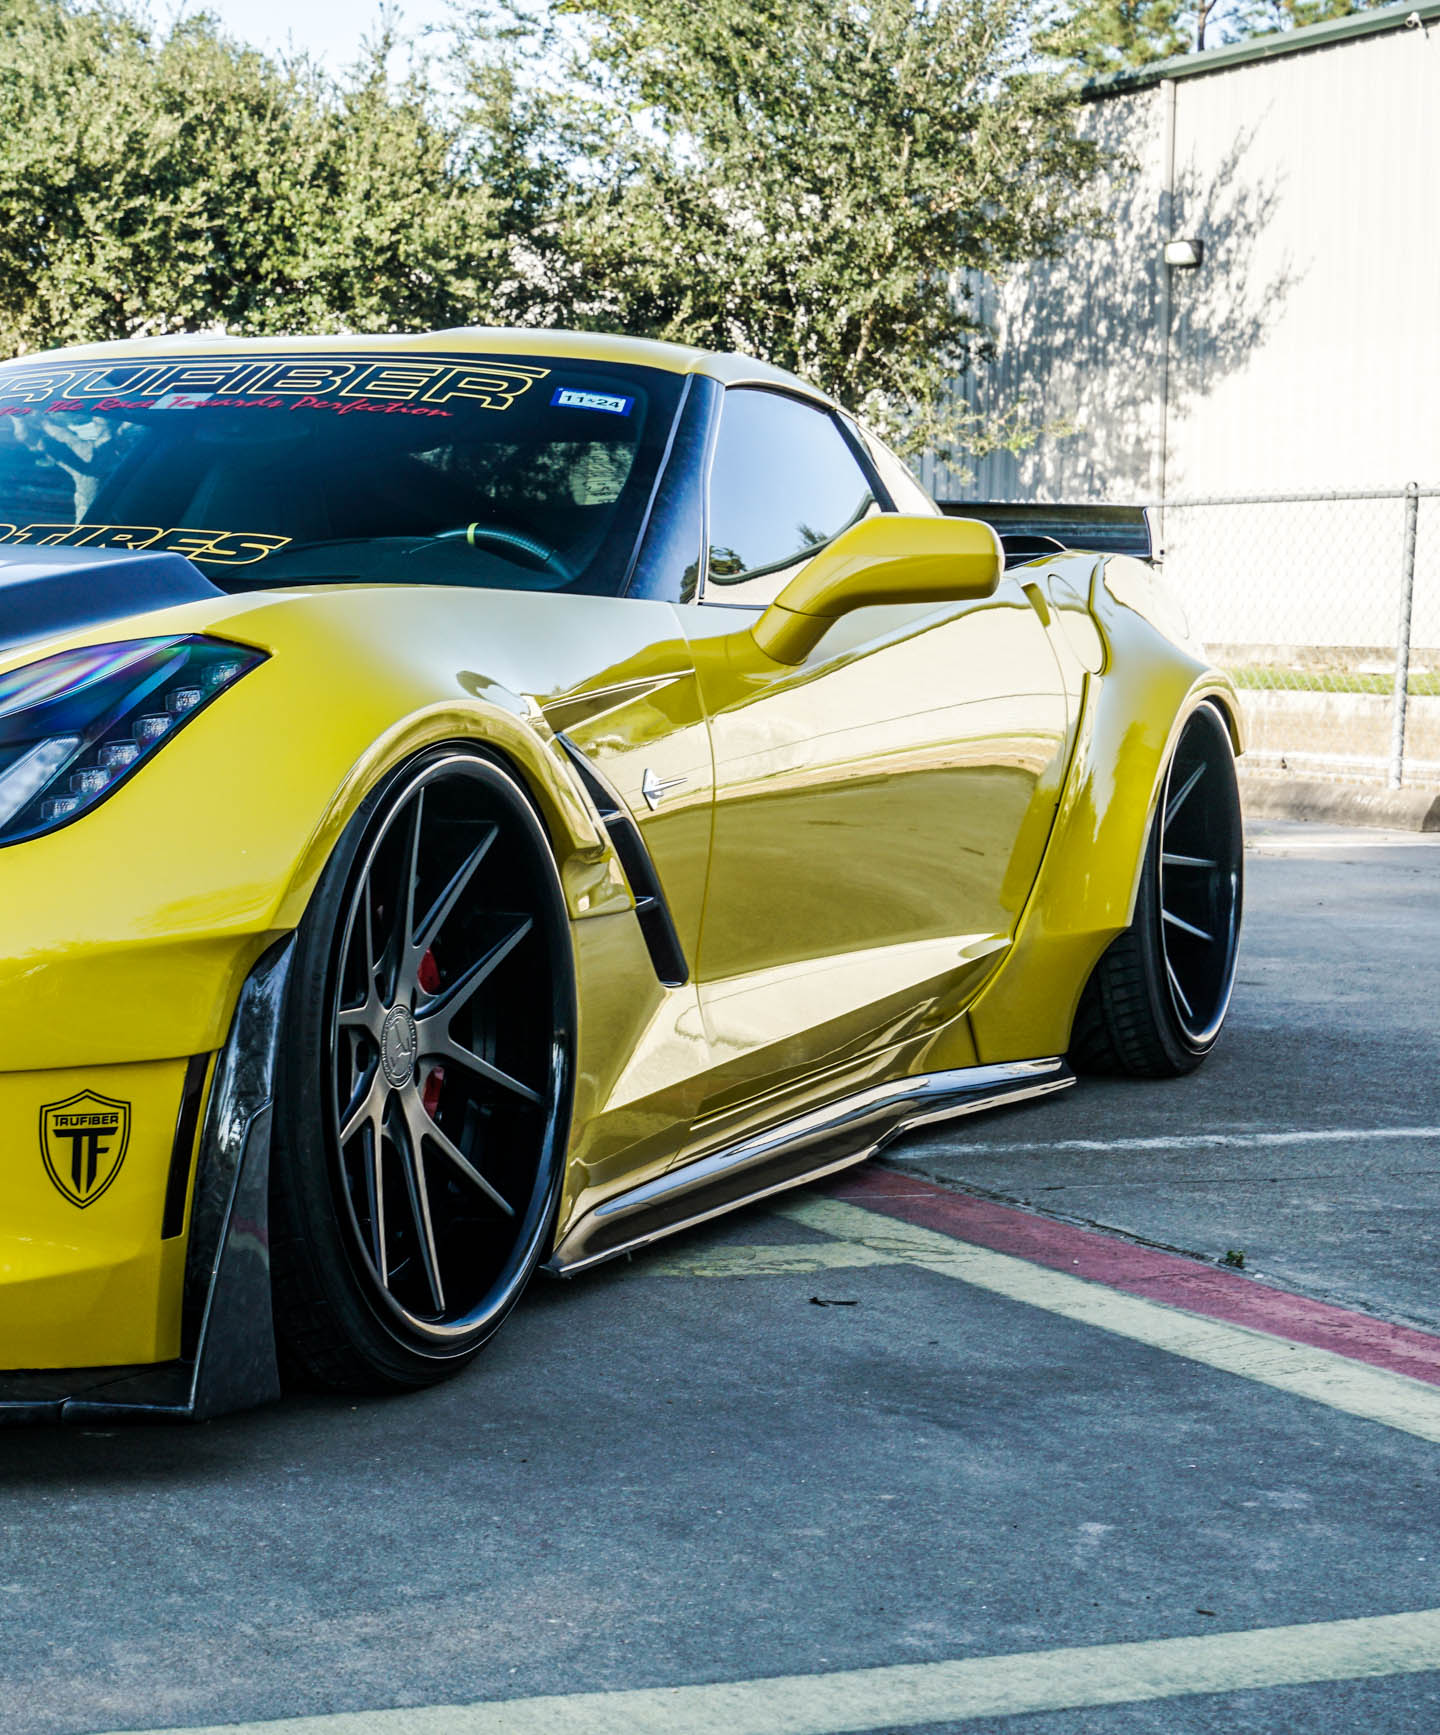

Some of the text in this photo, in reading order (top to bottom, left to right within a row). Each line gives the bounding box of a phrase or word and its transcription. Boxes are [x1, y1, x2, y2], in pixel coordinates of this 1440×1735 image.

[90, 397, 155, 412] Race
[166, 395, 285, 410] Towards
[289, 396, 454, 416] Perfection
[52, 1111, 120, 1127] TRUFIBER
[51, 1126, 119, 1194] TF
